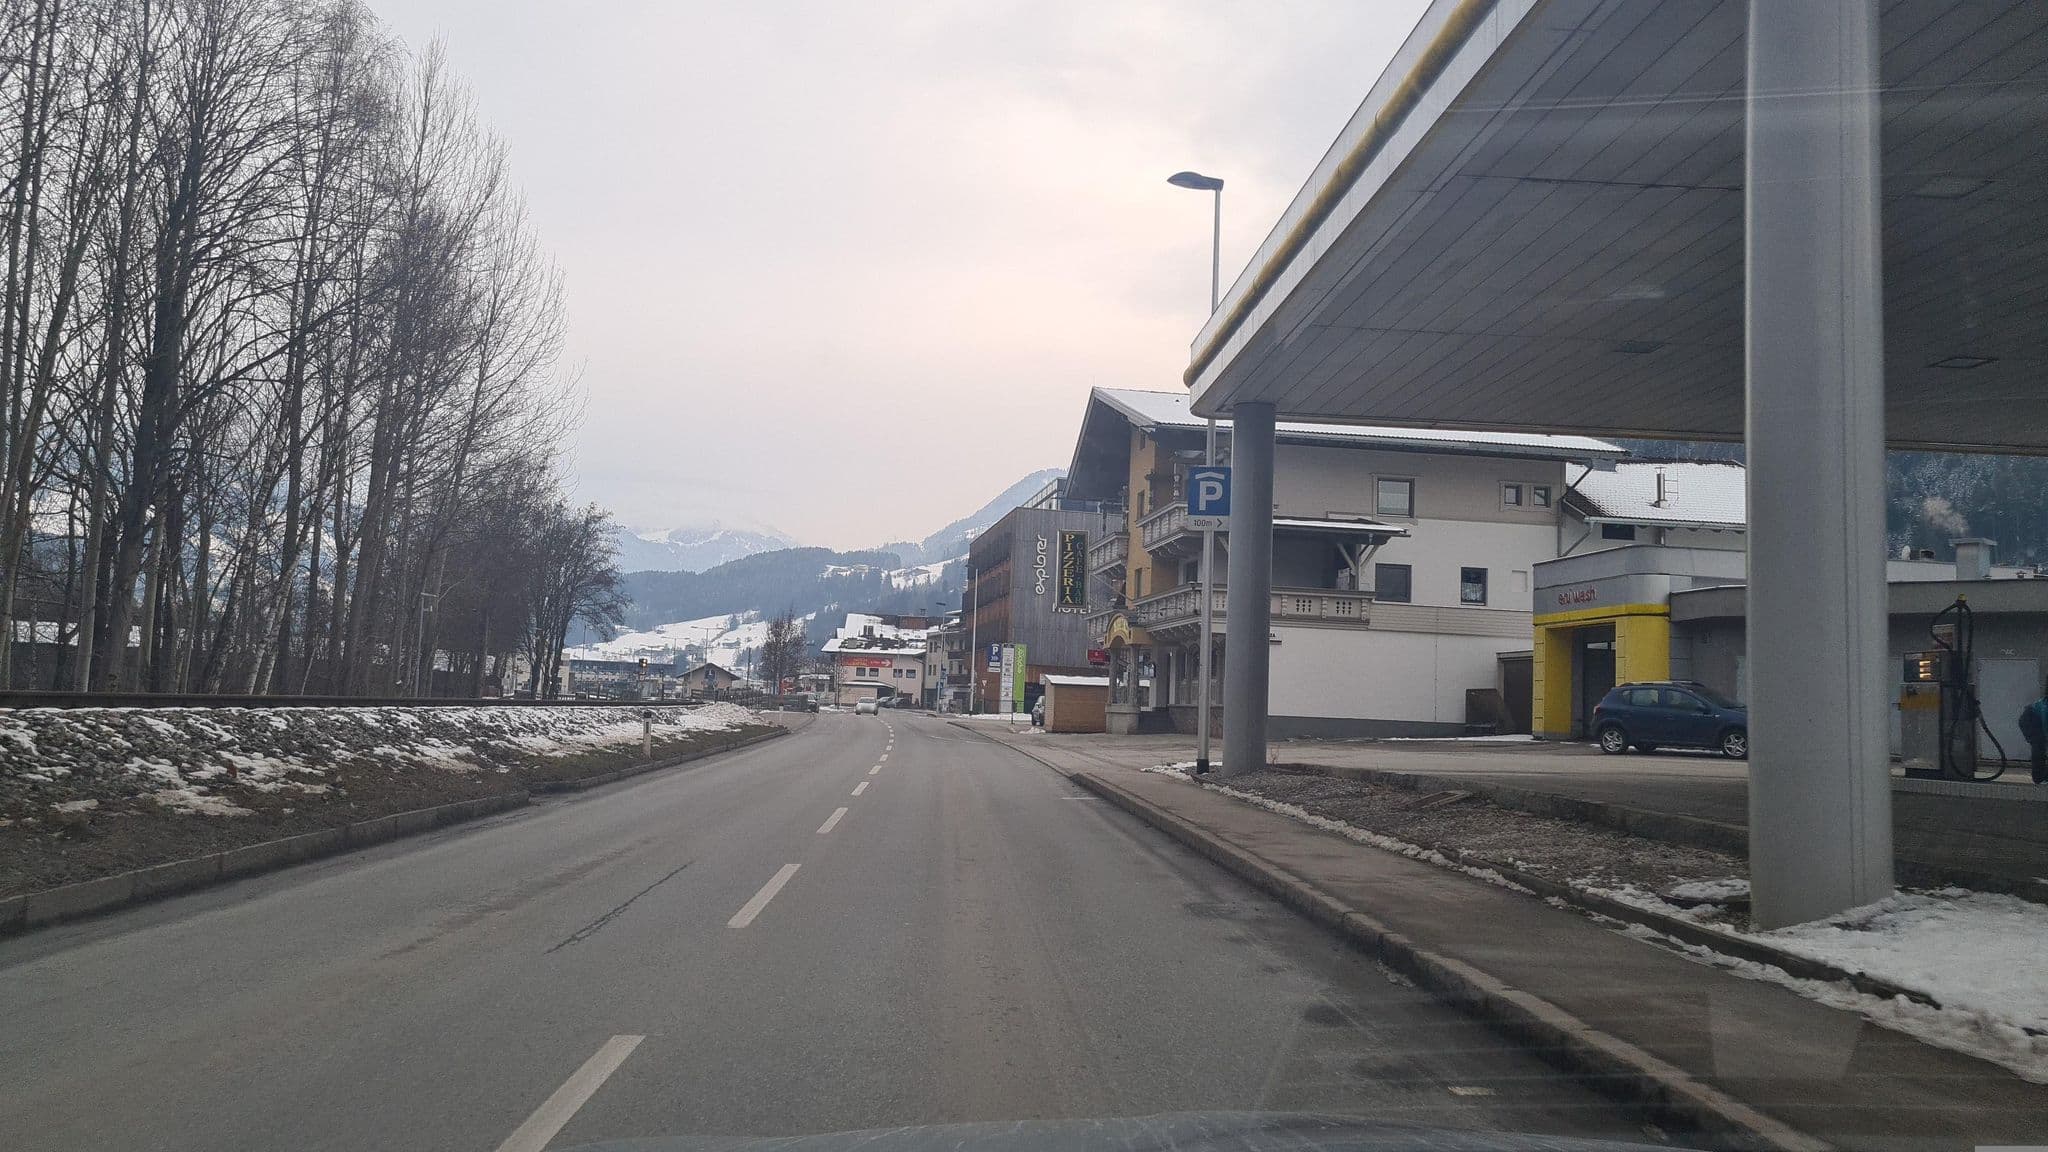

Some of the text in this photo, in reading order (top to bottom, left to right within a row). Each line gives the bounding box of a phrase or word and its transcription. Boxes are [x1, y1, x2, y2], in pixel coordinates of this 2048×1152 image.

[1199, 481, 1223, 511] P
[1194, 519, 1213, 527] 100m
[1032, 534, 1050, 595] explorer
[1063, 534, 1075, 604] PIZZERIA
